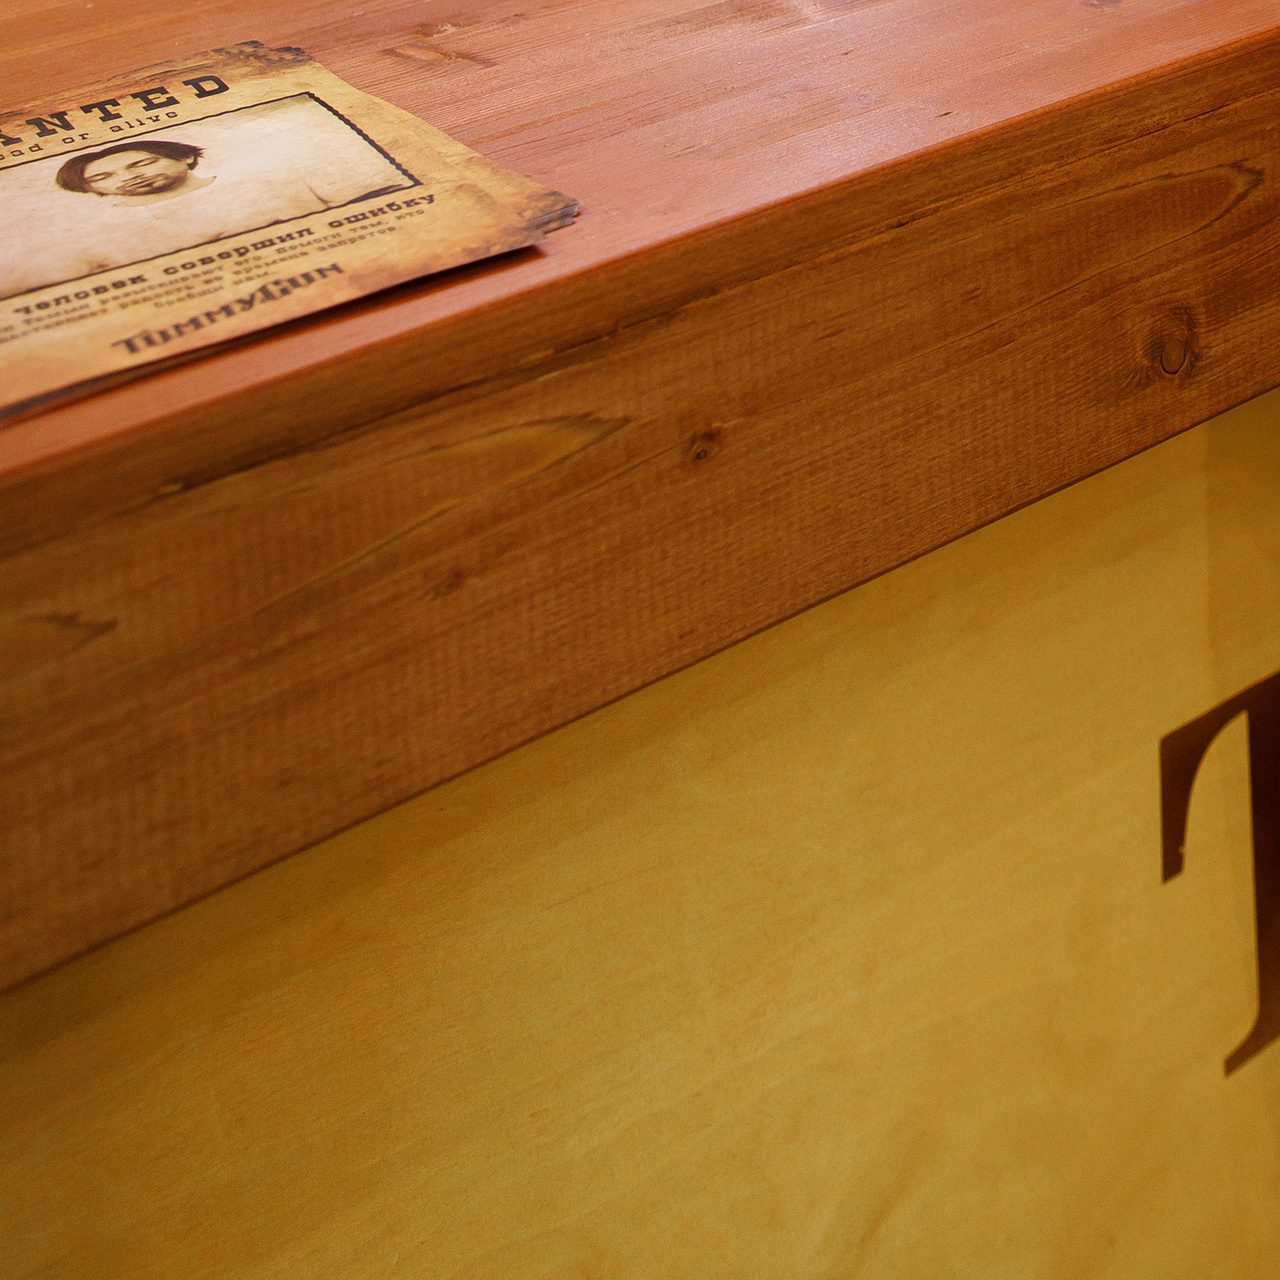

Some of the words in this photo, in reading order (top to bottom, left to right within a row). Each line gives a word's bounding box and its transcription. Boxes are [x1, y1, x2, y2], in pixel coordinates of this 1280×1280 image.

[61, 132, 90, 144] or
[108, 111, 179, 133] alive
[13, 274, 149, 316] человек
[163, 227, 315, 276] совершил
[327, 193, 436, 229] ошибку
[275, 230, 342, 255] Помоги
[395, 208, 426, 221] кто
